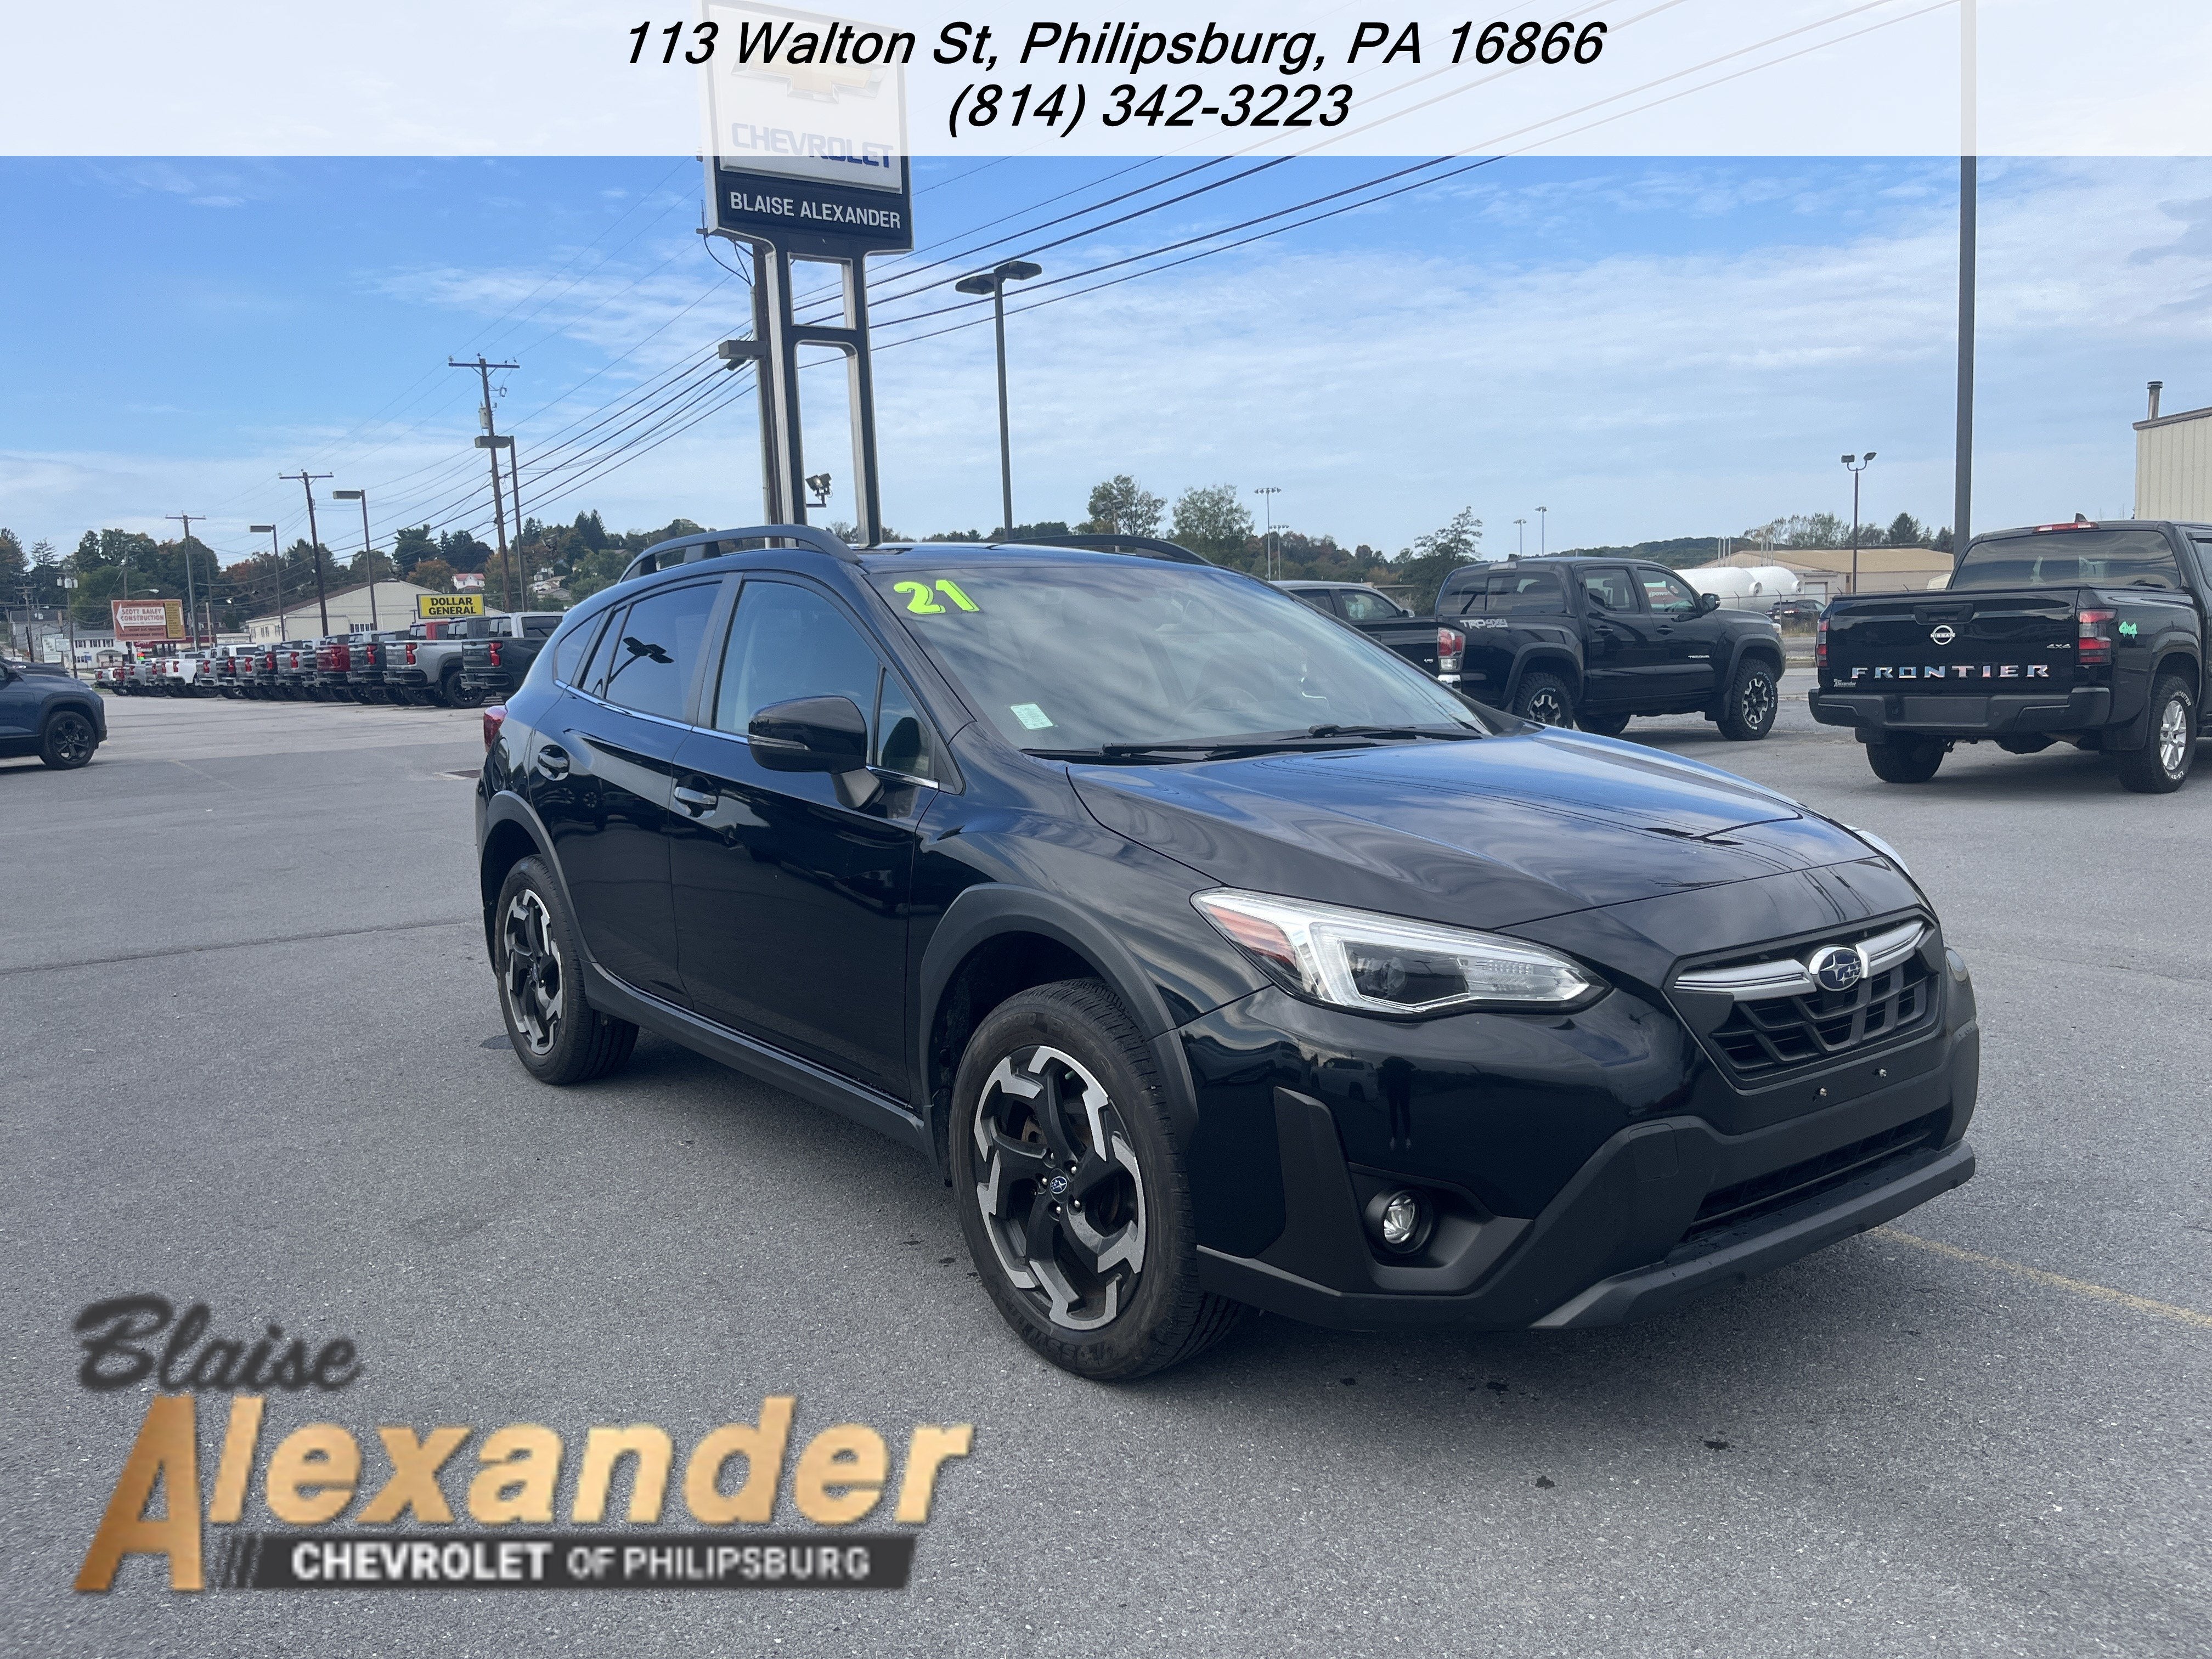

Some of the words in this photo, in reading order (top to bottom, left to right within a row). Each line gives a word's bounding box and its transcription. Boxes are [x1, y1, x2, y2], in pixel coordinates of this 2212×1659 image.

[732, 122, 894, 168] CHEVROLET
[730, 191, 794, 216] BLAISE
[800, 201, 901, 229] ALEXANDER
[430, 597, 473, 606] DOLLAR
[894, 580, 980, 614] 21
[428, 606, 477, 615] GENERAL
[1850, 664, 2049, 679] FRONTIER
